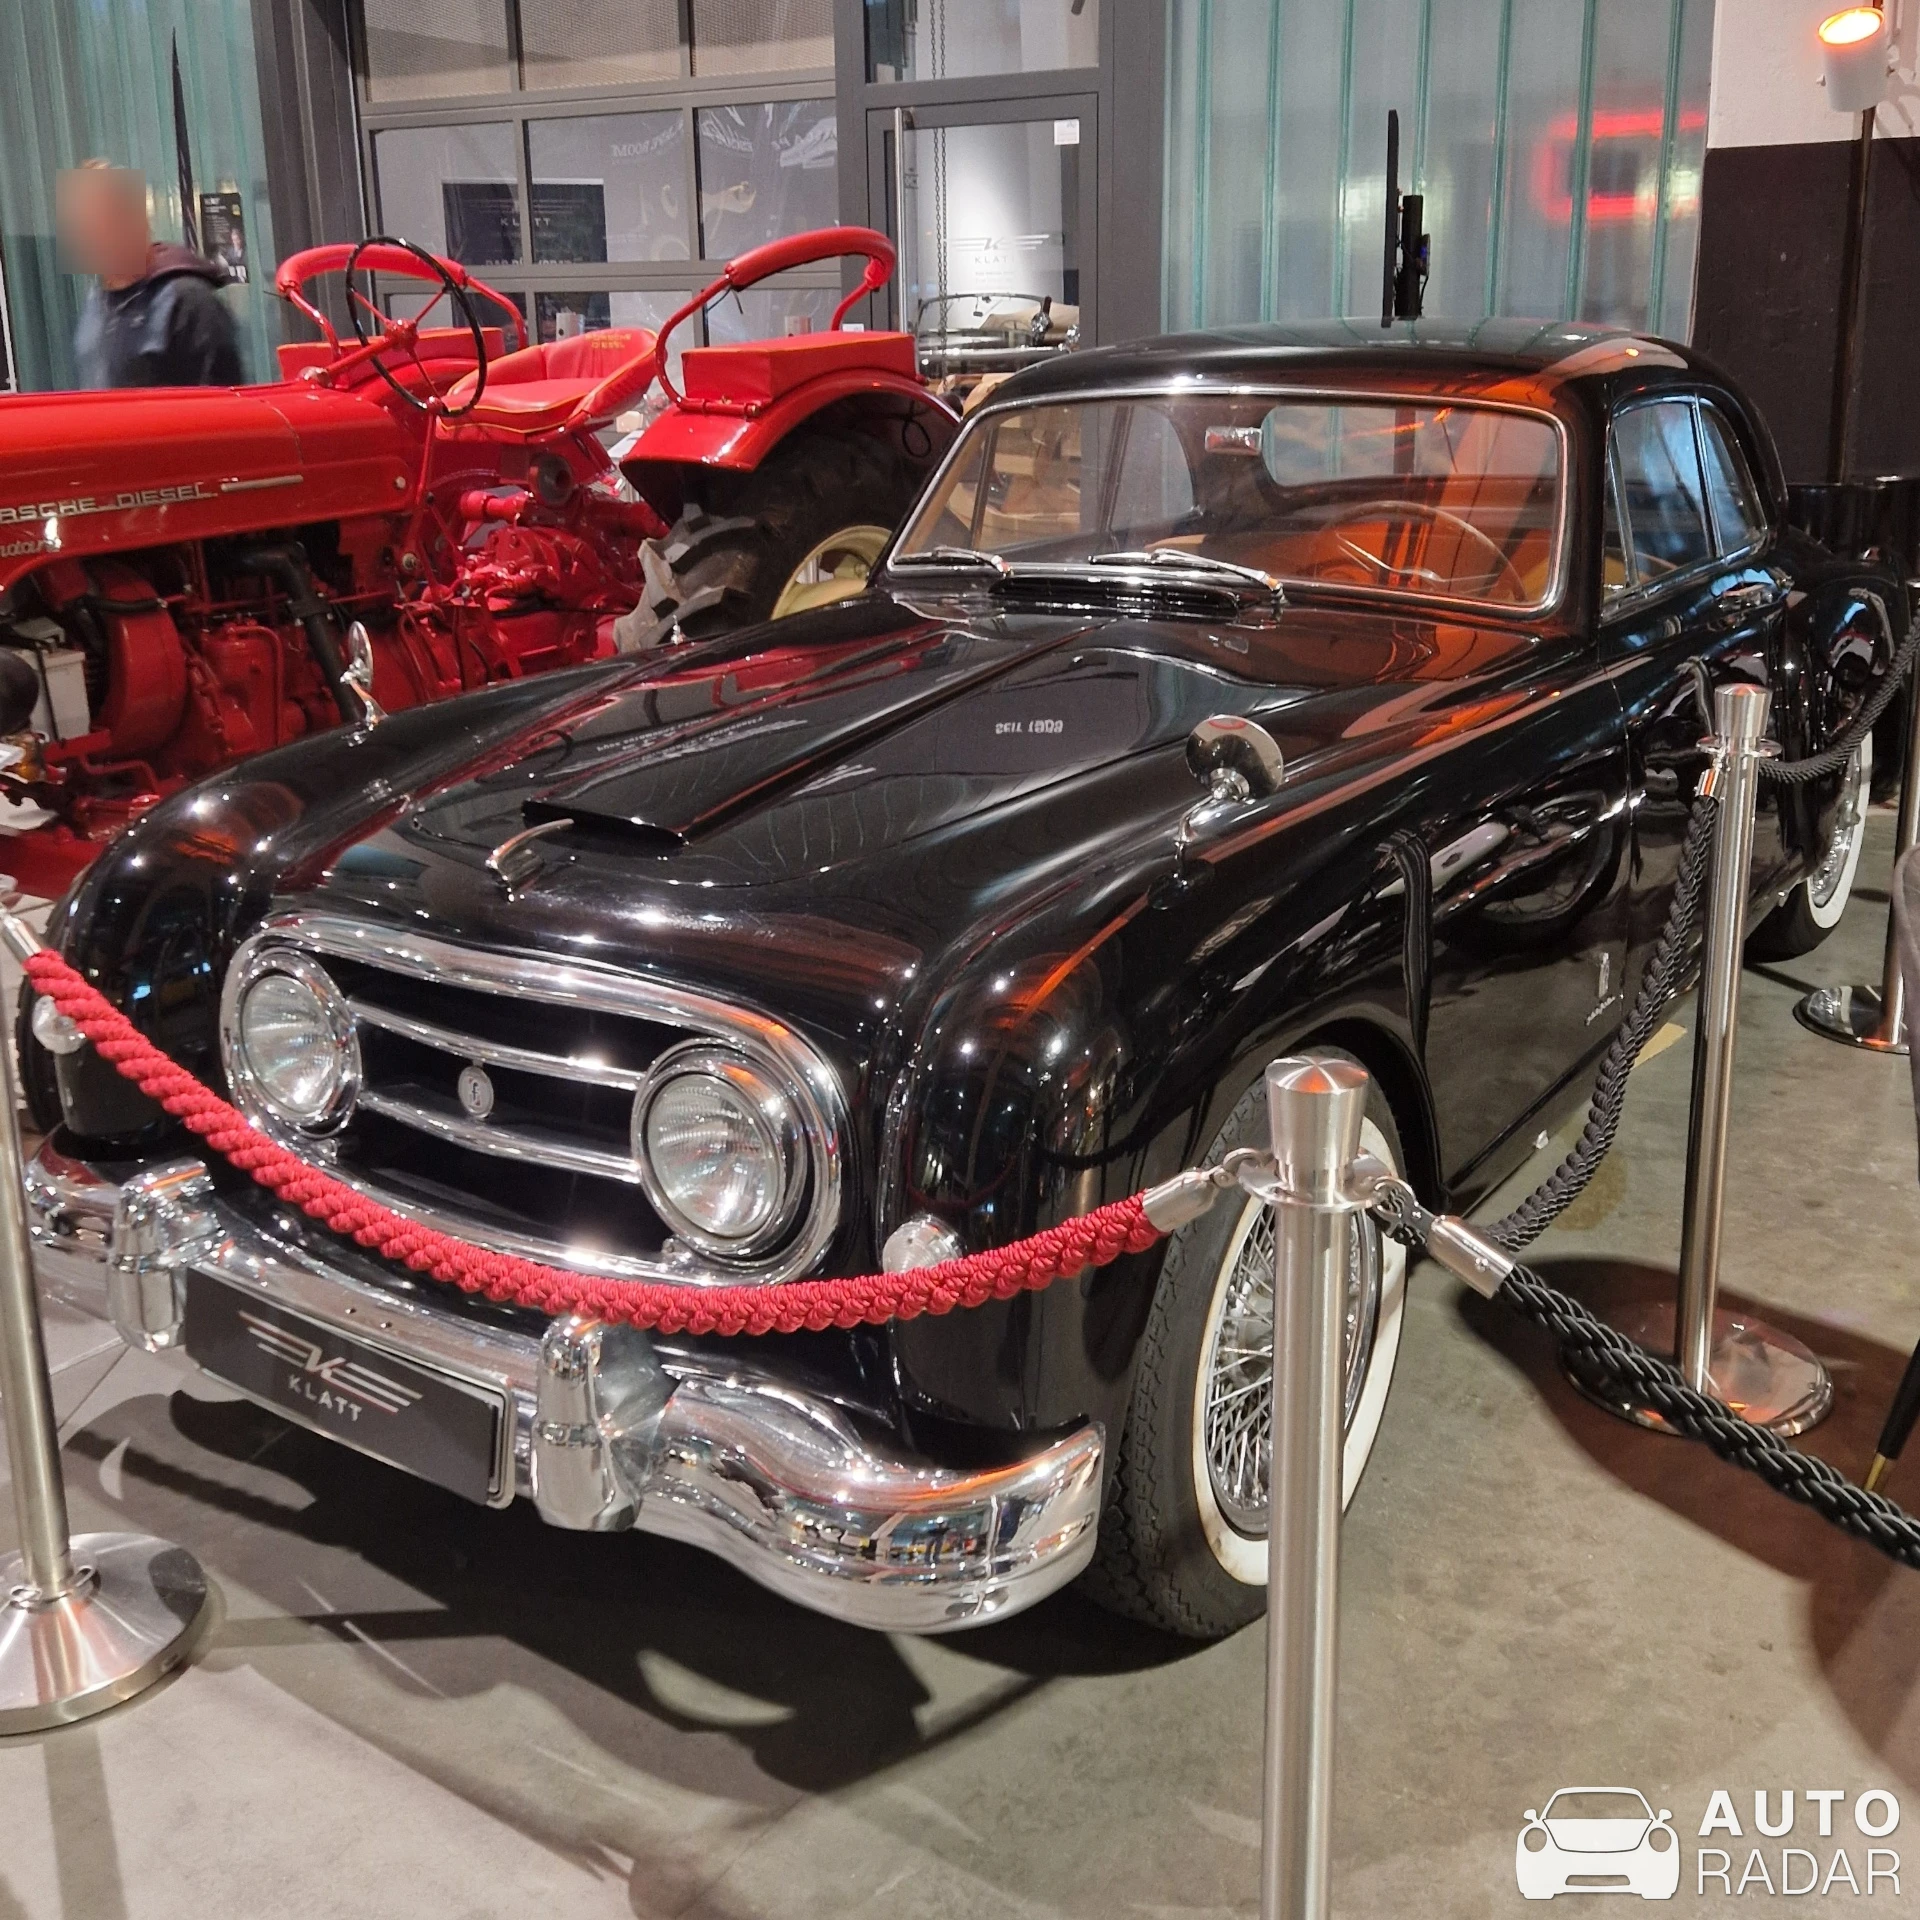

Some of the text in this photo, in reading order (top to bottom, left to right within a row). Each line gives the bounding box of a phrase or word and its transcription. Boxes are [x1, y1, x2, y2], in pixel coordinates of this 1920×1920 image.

[500, 217, 550, 226] KLTT
[116, 482, 218, 508] DIESEL
[288, 1374, 363, 1422] KLATT
